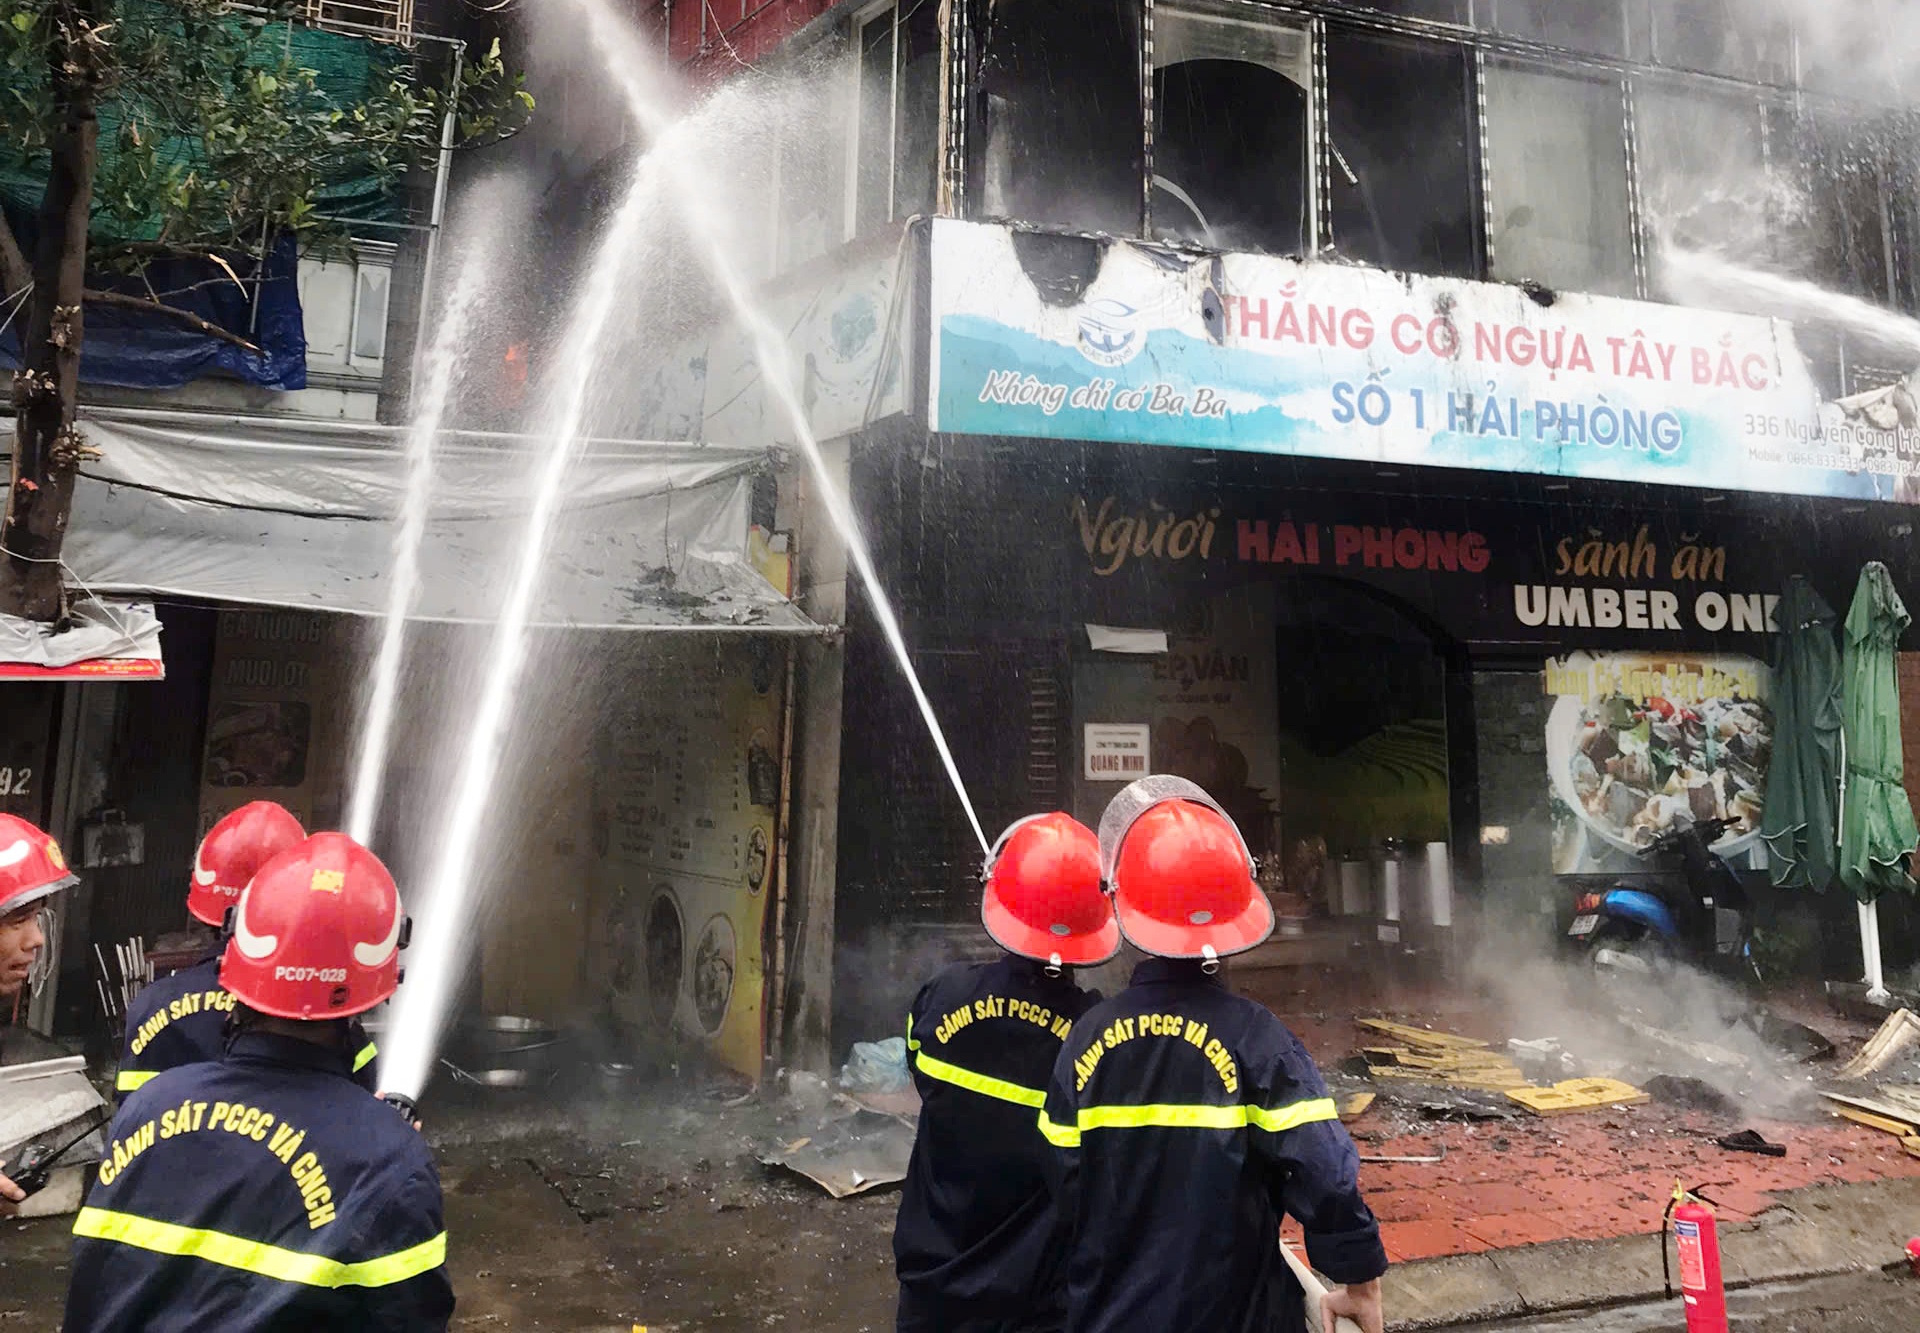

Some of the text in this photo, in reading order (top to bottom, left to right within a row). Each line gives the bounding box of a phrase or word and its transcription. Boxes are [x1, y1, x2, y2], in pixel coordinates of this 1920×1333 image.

[1223, 280, 1374, 349] THẮNG
[1475, 322, 1595, 381] NGỰA
[1607, 329, 1676, 381] TÂY
[1691, 333, 1768, 391] BẮC
[980, 369, 1228, 417] Không chỉ có Ba Ba
[1331, 366, 1682, 452] SỐ 1 HẢI PHÒNG
[1745, 414, 1779, 437] 336
[1672, 531, 1725, 581] ăn
[1514, 584, 1682, 630] UMBER
[1091, 755, 1119, 773] QUANG
[275, 966, 347, 982] PC07-028
[131, 1009, 169, 1056] CẢNH
[169, 992, 202, 1021] SÁT
[934, 994, 1074, 1045] CẢNH SÁT PCCC VÀ
[1103, 1018, 1136, 1050] SÁT
[1137, 1013, 1185, 1037] PCCC
[1184, 1019, 1209, 1050] VÀ
[98, 1099, 337, 1230] CẢNH SÁT PCCC VÀ CNCH
